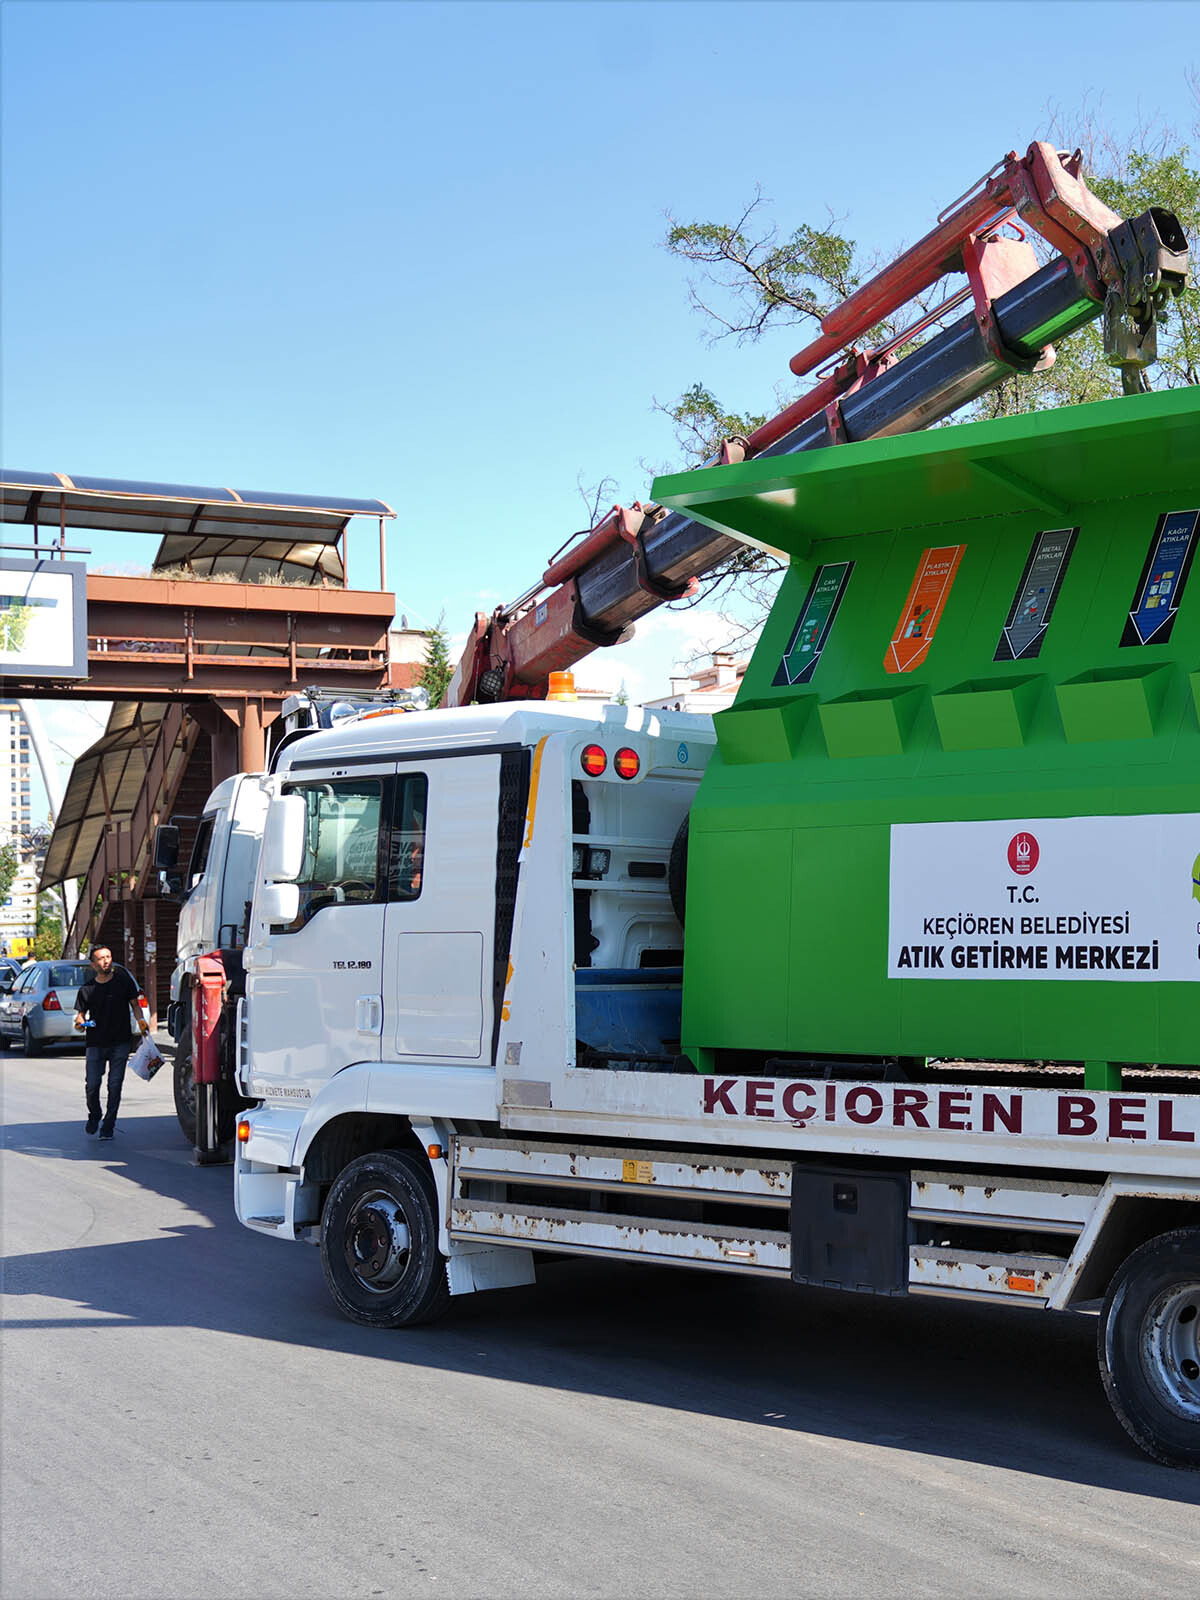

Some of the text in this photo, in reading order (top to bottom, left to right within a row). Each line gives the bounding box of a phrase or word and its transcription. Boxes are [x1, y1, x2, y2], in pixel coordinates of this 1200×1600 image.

[1167, 527, 1189, 536] KAĞIT
[1161, 534, 1190, 544] ATIKLAR
[1042, 545, 1063, 553] METAL
[1036, 552, 1063, 560] ATIKLAR
[924, 569, 949, 577] ATIKLAR
[816, 585, 839, 593] ATIKLAR
[1006, 885, 1039, 903] T.C.
[923, 911, 1130, 940] KEÇİÖREN BELEDİYESİ
[897, 939, 1159, 970] ATIK GETİRME MERKEZİ
